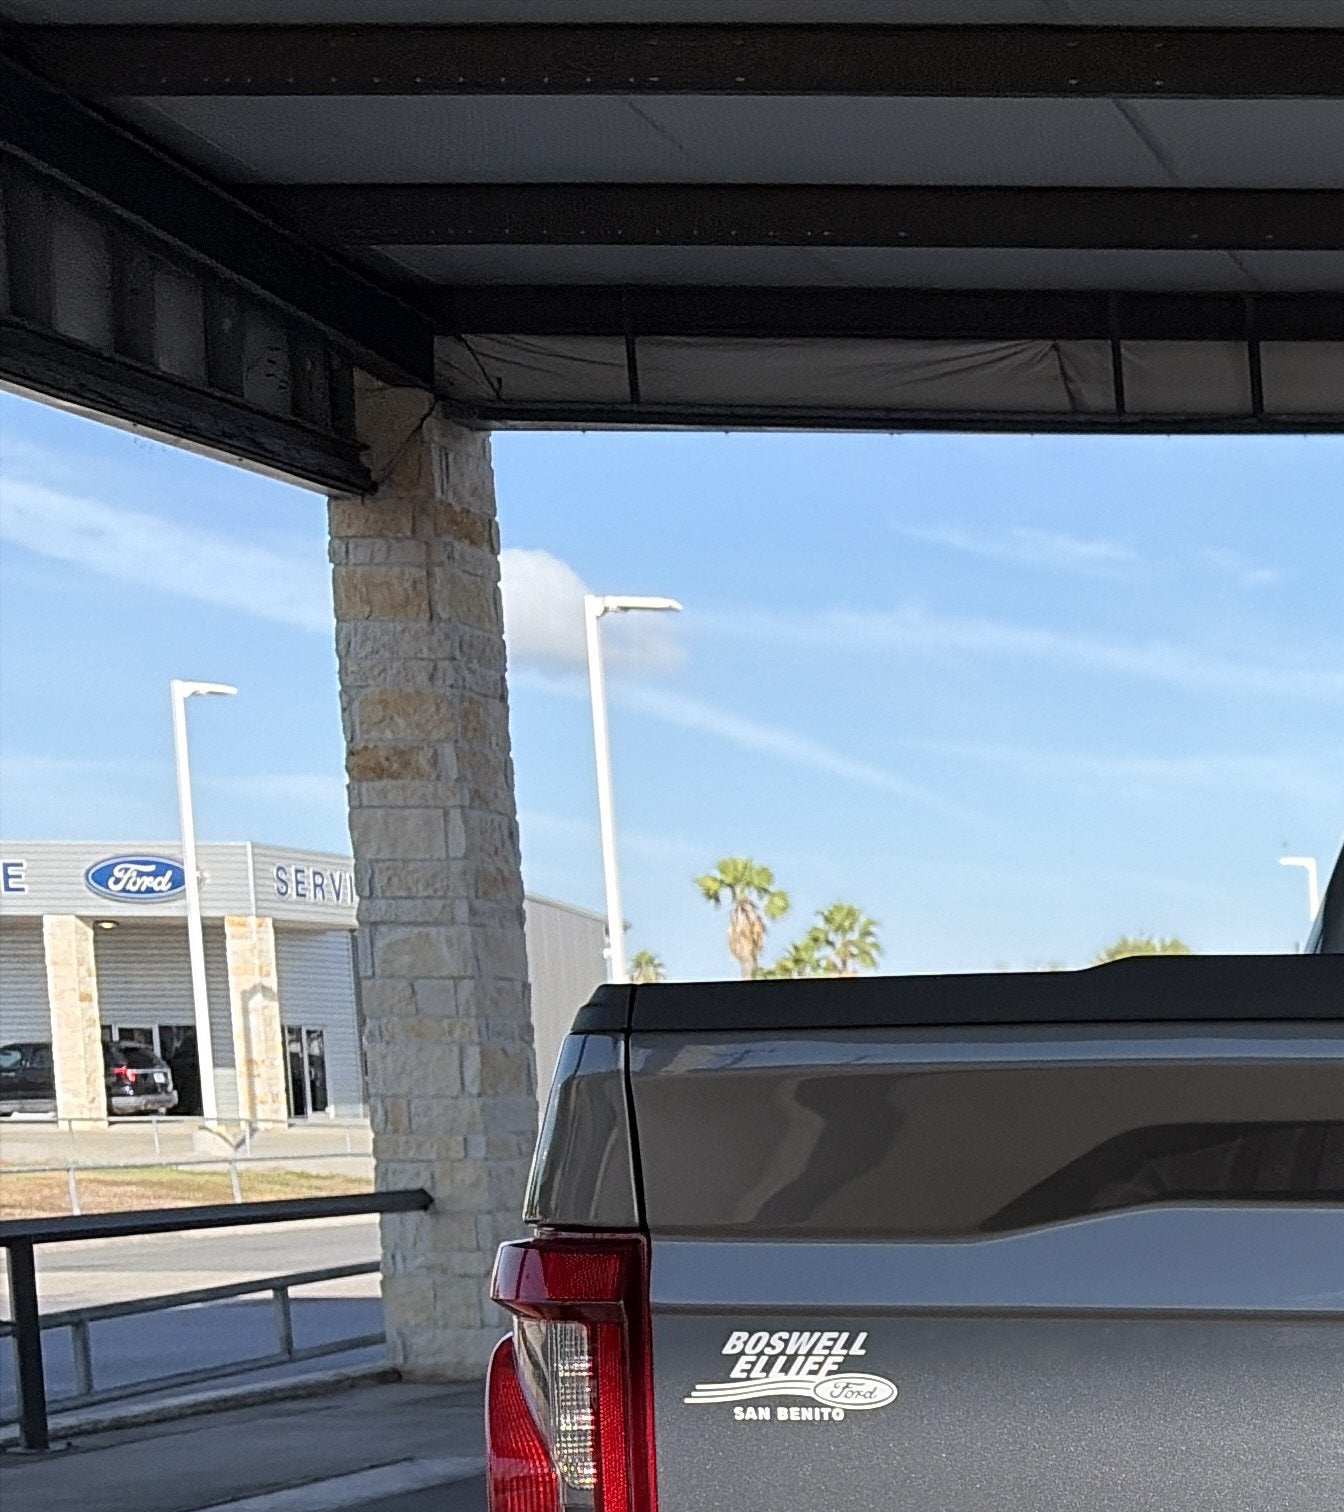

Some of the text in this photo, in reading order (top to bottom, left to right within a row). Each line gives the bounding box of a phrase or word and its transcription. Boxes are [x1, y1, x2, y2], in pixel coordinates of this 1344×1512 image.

[107, 863, 173, 892] Ford
[721, 1331, 868, 1356] BOSWELL
[729, 1356, 844, 1379] ELLIFF
[830, 1382, 878, 1399] Ford
[733, 1407, 845, 1421] SAN BENITO
